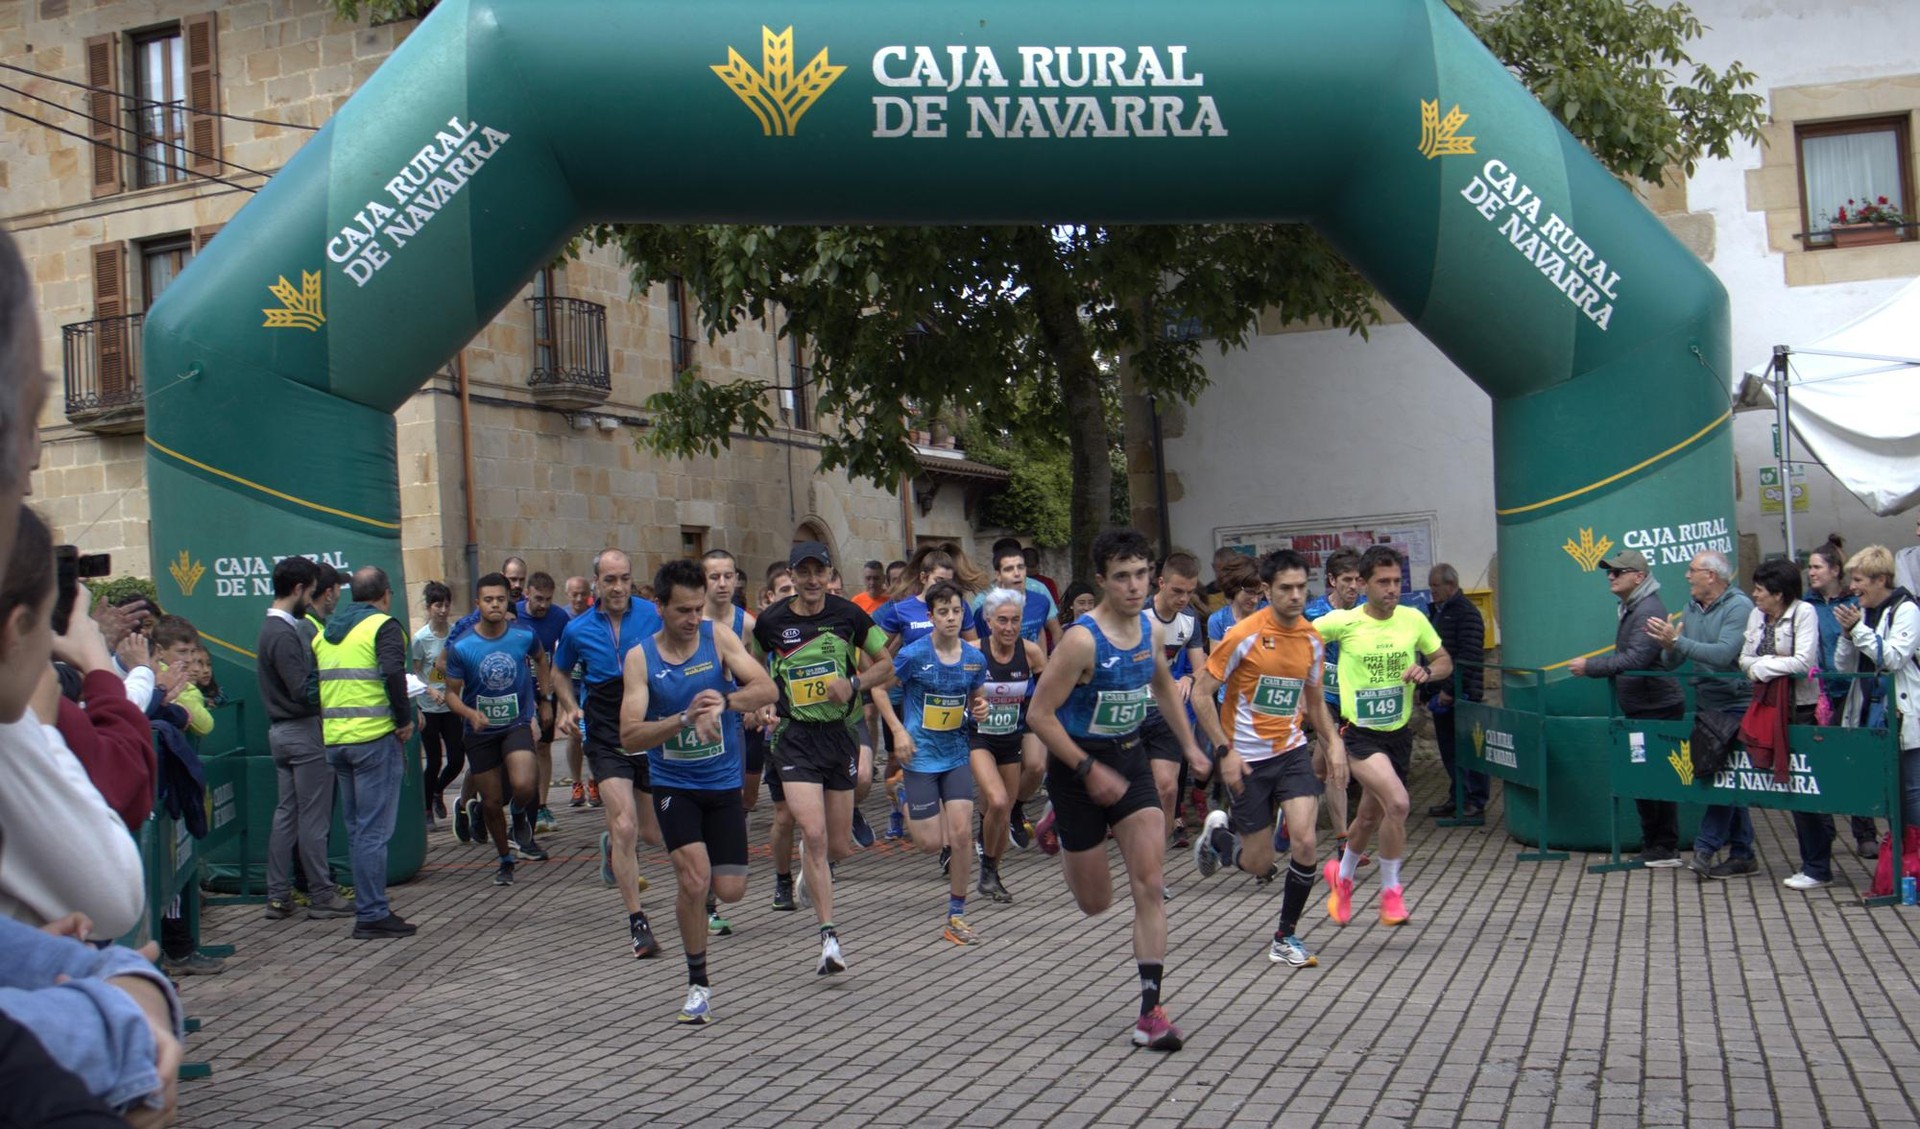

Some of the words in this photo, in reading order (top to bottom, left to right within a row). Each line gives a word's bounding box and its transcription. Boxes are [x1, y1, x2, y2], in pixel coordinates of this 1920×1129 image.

[872, 45, 1008, 92] CAJA
[1018, 45, 1204, 88] RURAL
[872, 96, 948, 138] DE
[967, 96, 1229, 138] NAVARRA
[327, 201, 396, 263] CAJA
[384, 116, 479, 205] RURAL
[343, 240, 392, 288] DE
[382, 126, 511, 248] NAVARRA
[1483, 159, 1542, 225] CAJA
[1540, 213, 1621, 300] RURAL
[1460, 175, 1506, 221] DE
[1498, 212, 1614, 331] NAVARRA
[1623, 527, 1676, 548] CAJA
[1678, 518, 1728, 542] RURAL
[214, 557, 270, 577] CAJA
[216, 578, 247, 596] DE
[1363, 655, 1383, 663] PRI
[1386, 651, 1408, 659] UDA
[1367, 662, 1384, 670] MA
[1386, 671, 1401, 679] KO
[804, 681, 826, 698] 78
[1266, 689, 1294, 705] 154
[485, 705, 510, 717] 162
[1366, 698, 1396, 715] 149
[941, 711, 950, 725] 7
[987, 713, 1012, 726] 100
[675, 730, 698, 748] 14
[1725, 750, 1753, 770] AJA
[1713, 770, 1736, 788] DE
